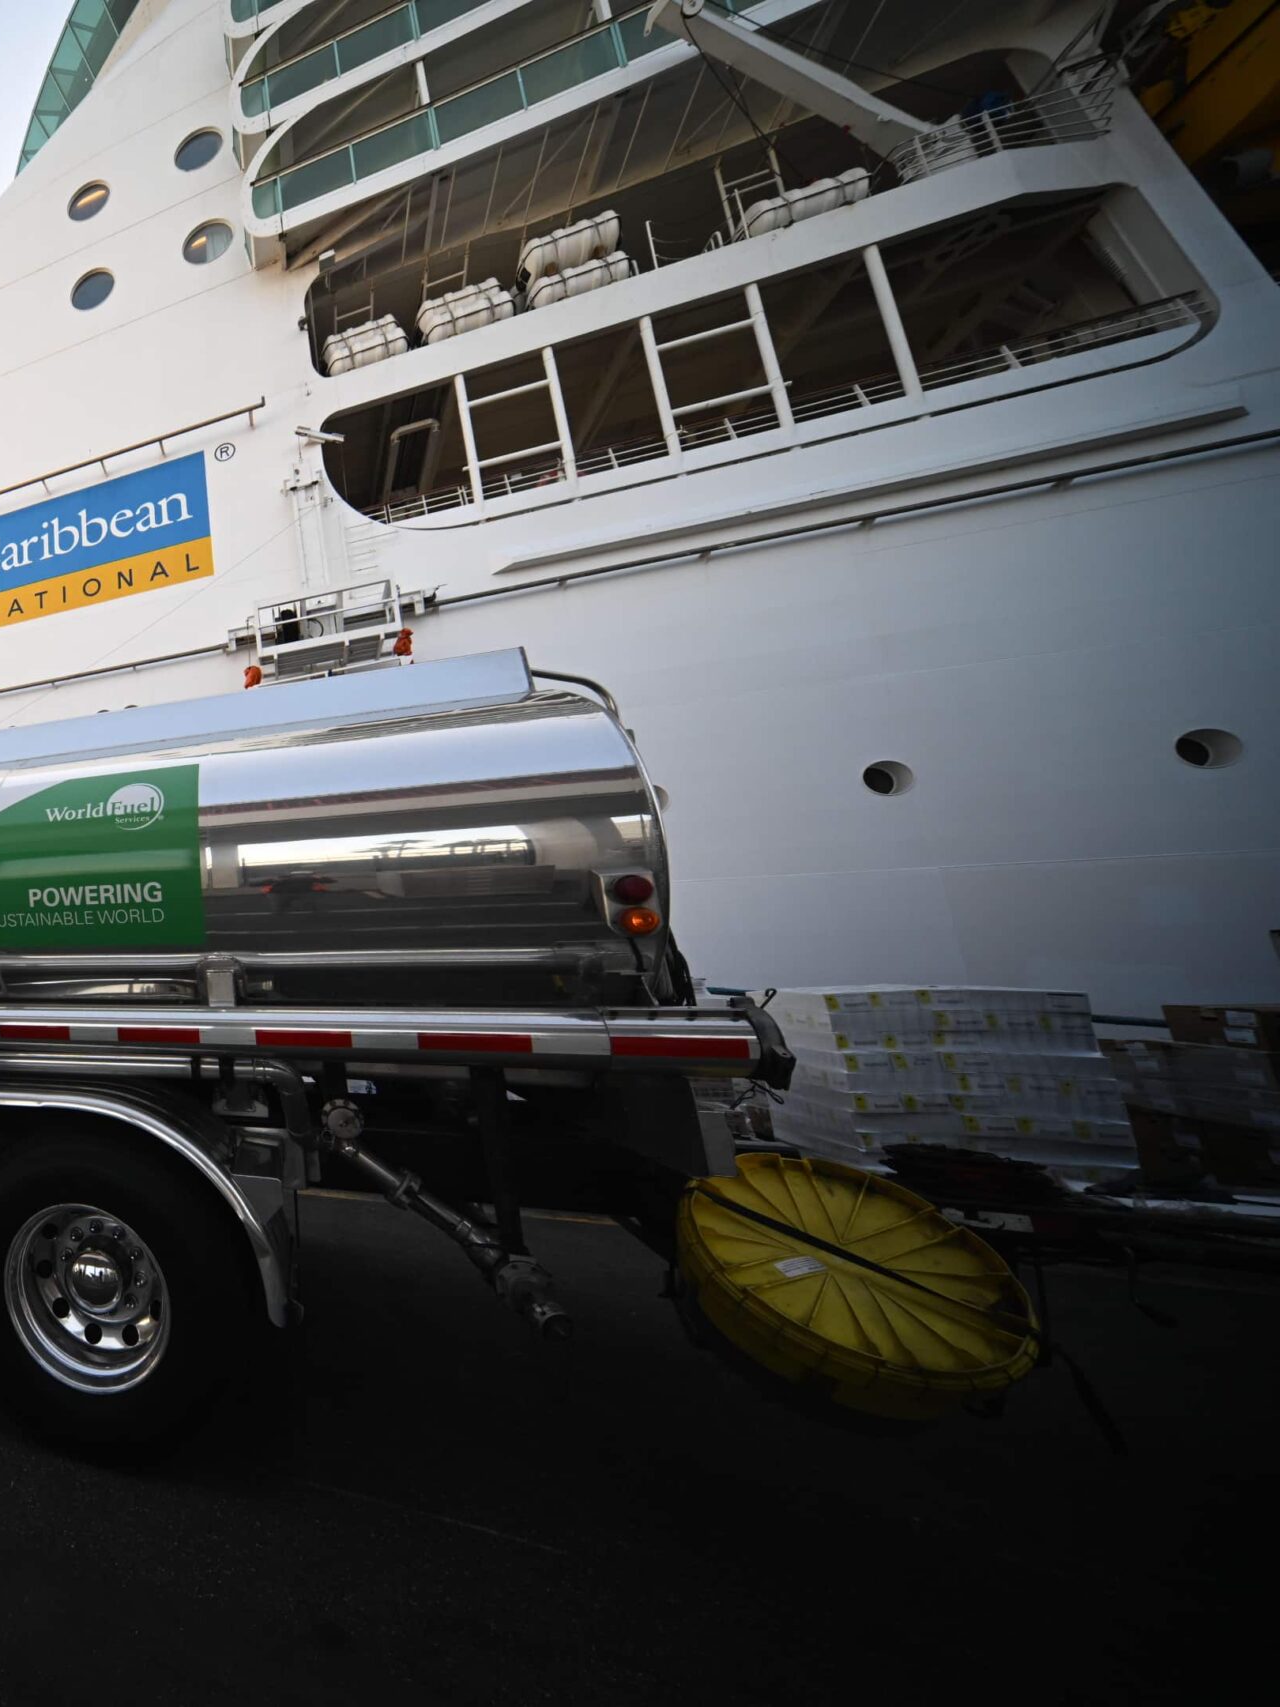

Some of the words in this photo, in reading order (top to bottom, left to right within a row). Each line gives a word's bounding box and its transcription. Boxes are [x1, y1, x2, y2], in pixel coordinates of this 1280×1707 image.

[45, 801, 104, 823] World
[110, 797, 155, 816] Fuel
[114, 815, 150, 825] Services
[28, 882, 163, 908] POWERING
[98, 908, 165, 925] WORLD
